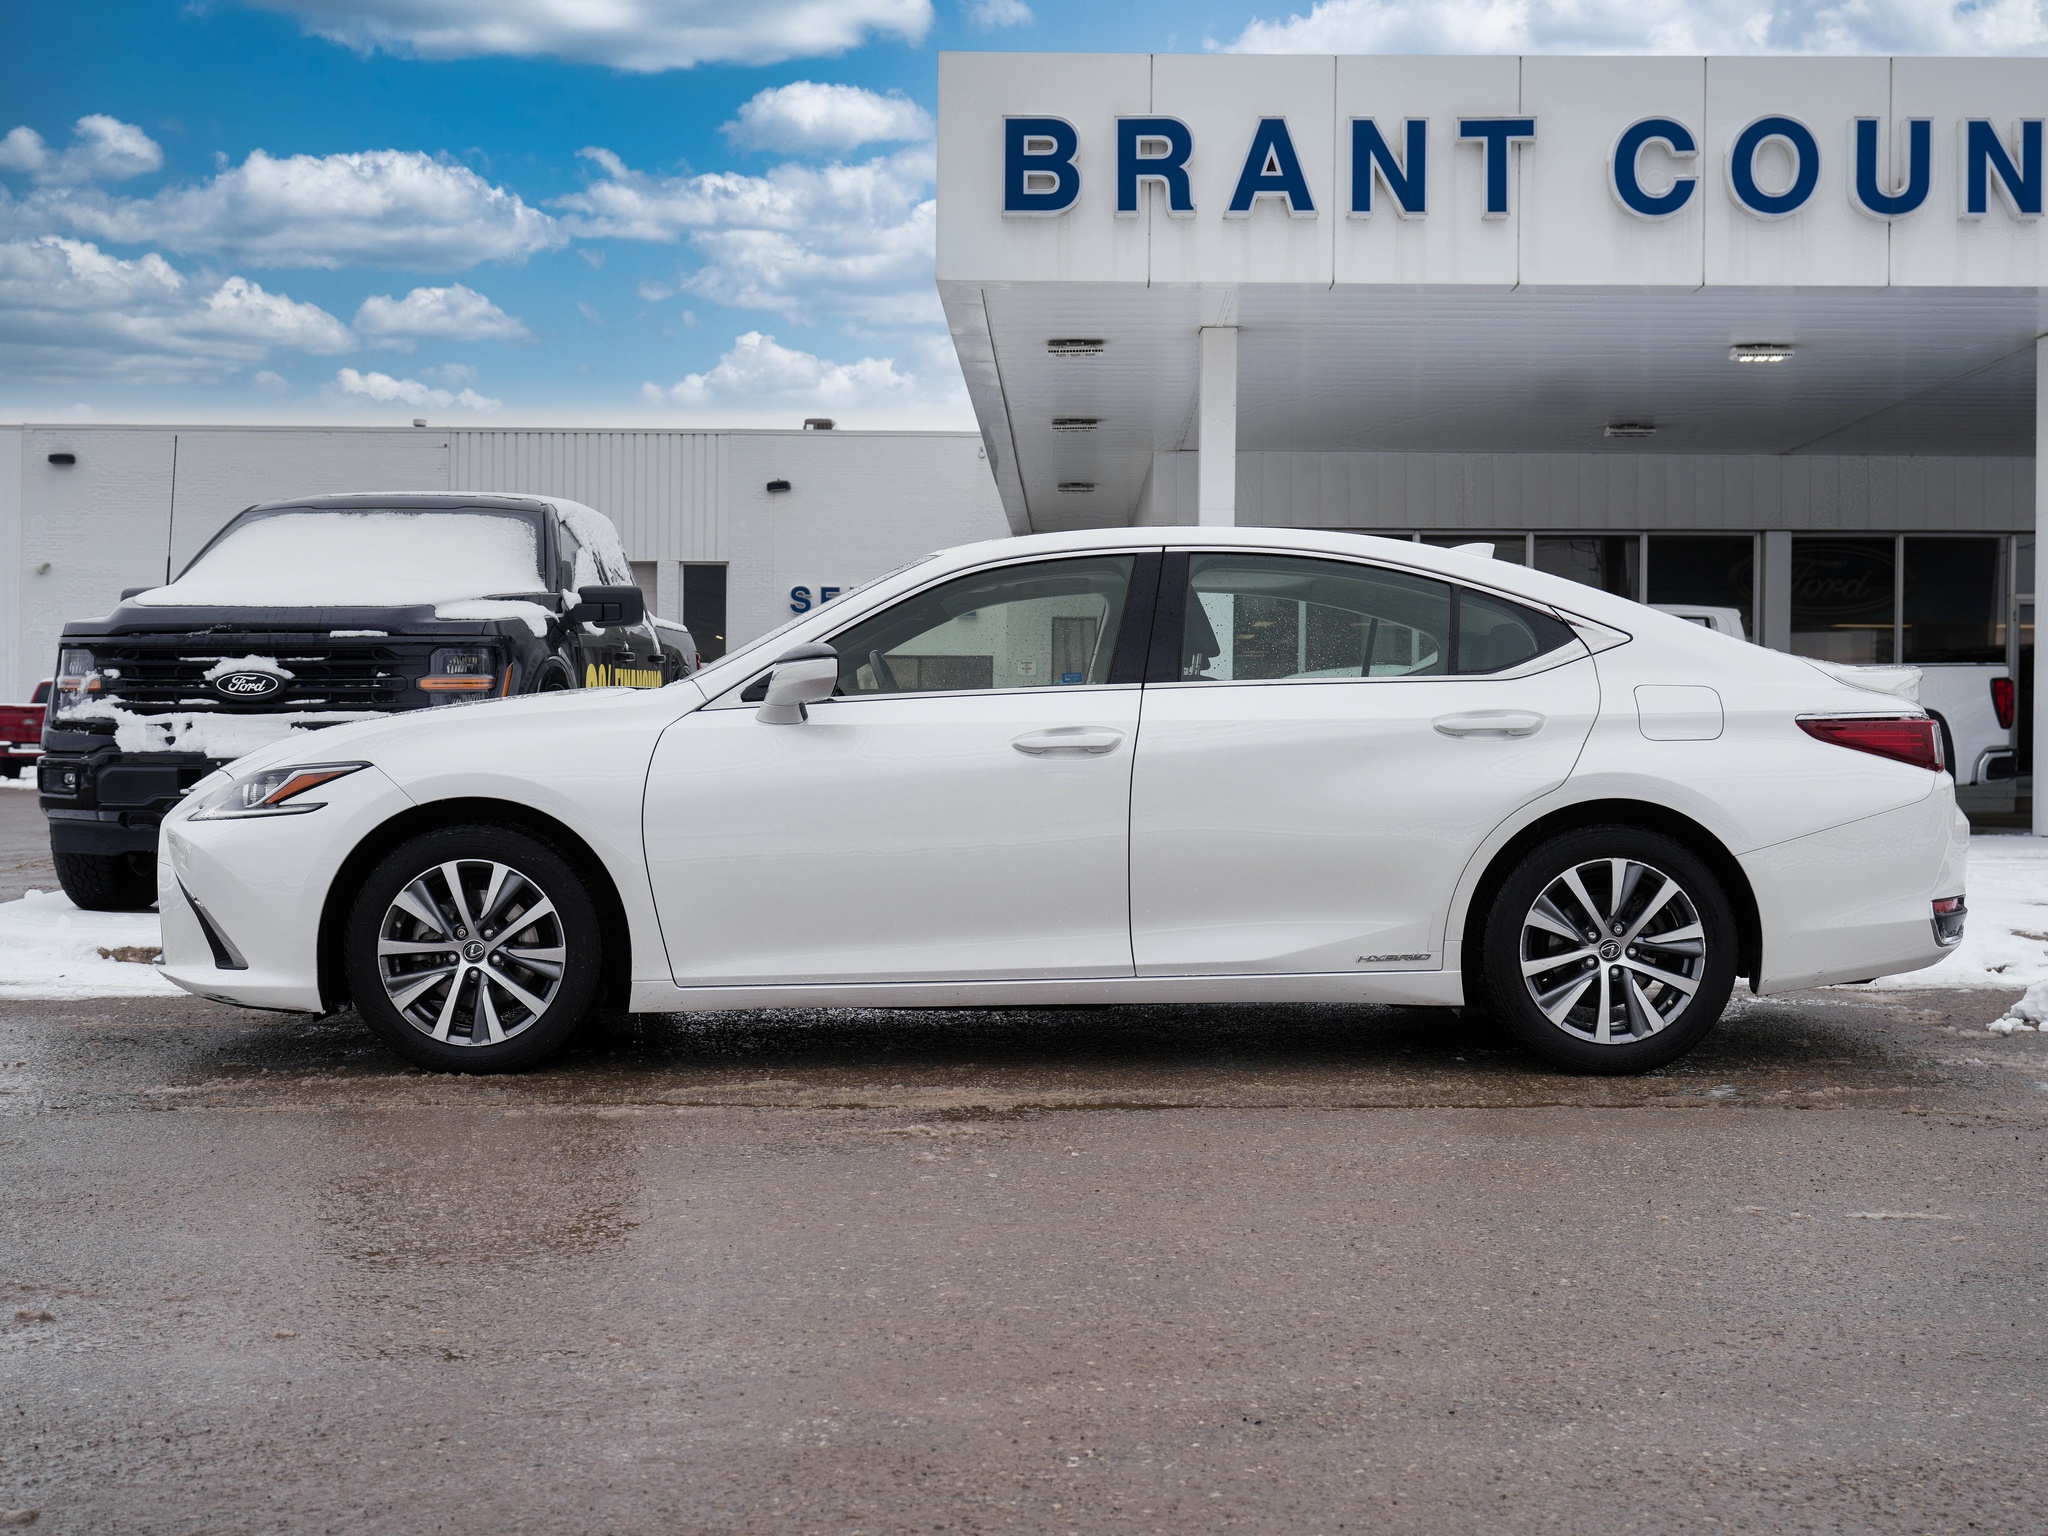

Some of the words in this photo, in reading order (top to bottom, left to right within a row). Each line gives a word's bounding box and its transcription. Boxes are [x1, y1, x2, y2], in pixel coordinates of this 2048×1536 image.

[1002, 115, 1537, 219] BRANT
[1608, 114, 2046, 220] COUN
[228, 676, 266, 691] Ford
[1356, 953, 1432, 963] HYBRID
